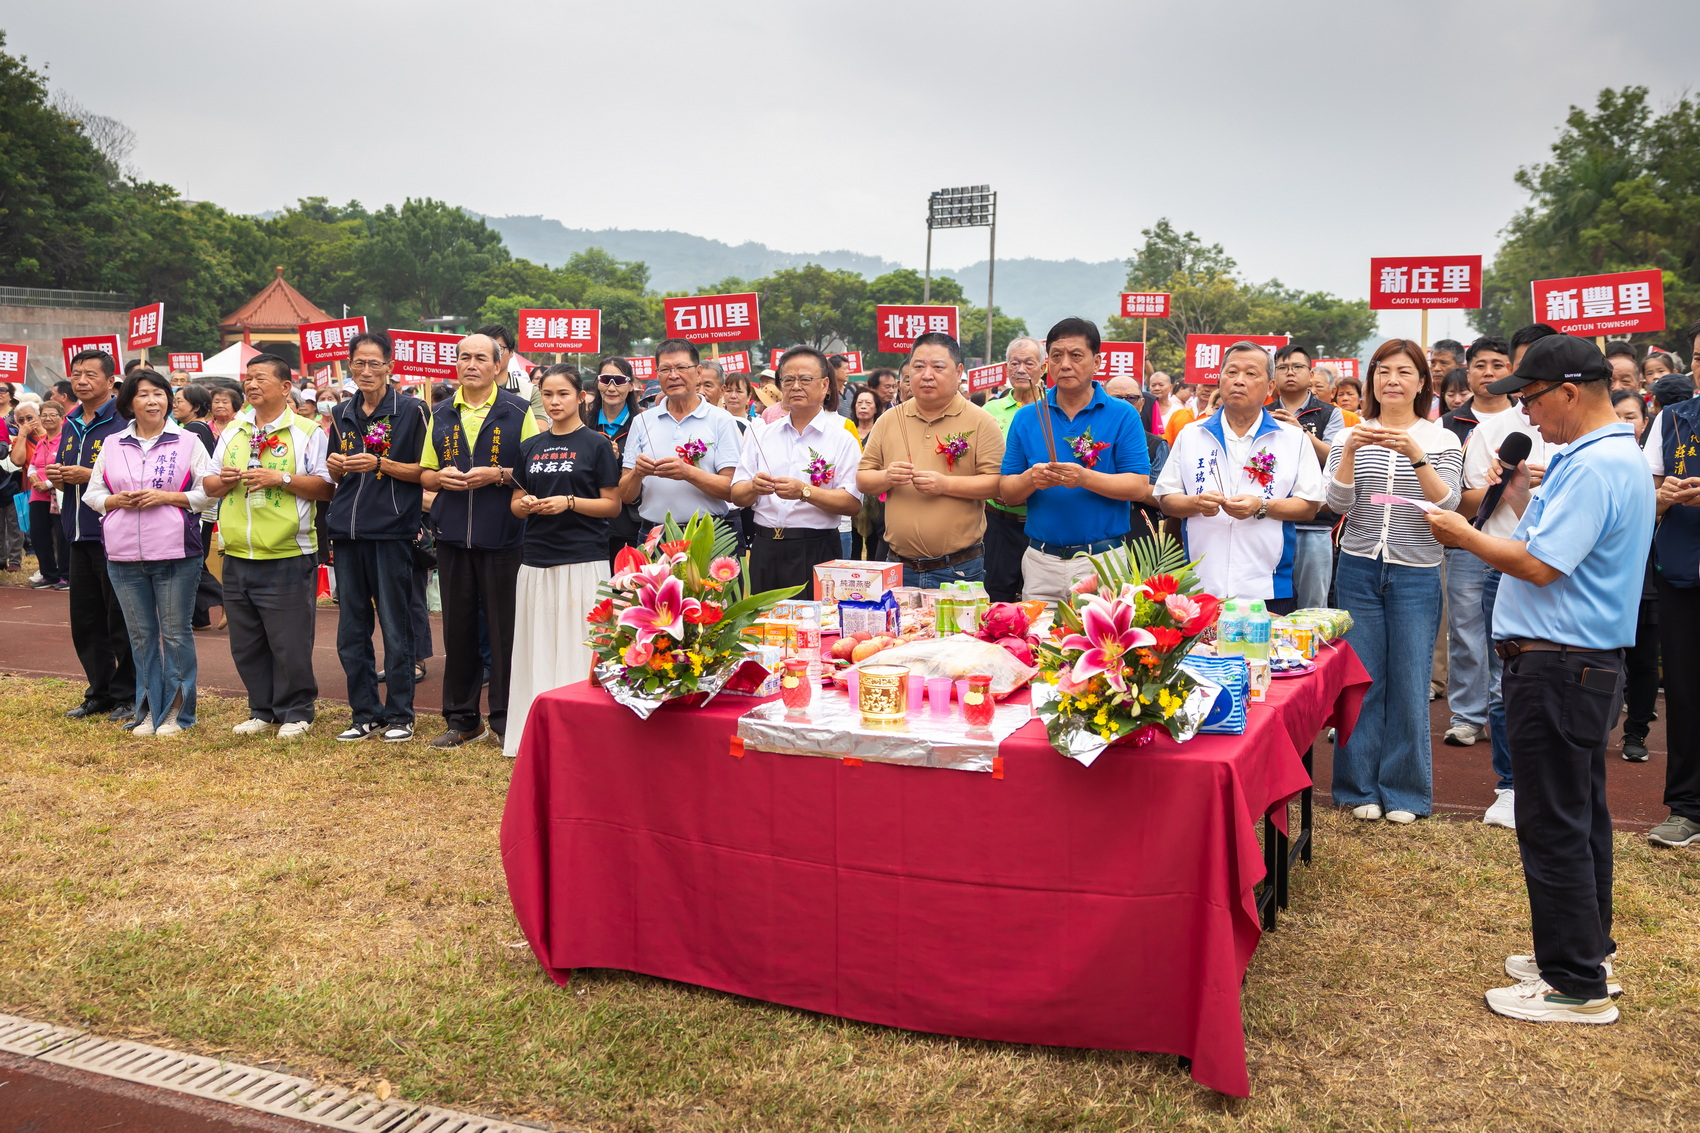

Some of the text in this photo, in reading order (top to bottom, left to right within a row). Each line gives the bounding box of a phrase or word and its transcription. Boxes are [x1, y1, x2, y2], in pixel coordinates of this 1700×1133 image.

[1380, 265, 1472, 294] 新庄里
[1545, 282, 1653, 321] 新豐里
[130, 311, 157, 338] 上林里
[525, 317, 592, 340] 碧峰里
[673, 302, 751, 331] 石川里
[884, 314, 949, 338] 北投里
[1561, 319, 1640, 333] CAOTUN TOWNSHIP
[305, 325, 361, 352] 復興里
[685, 330, 742, 340] CAOTUN TOWNSHIP
[394, 338, 458, 367] 新厝里
[402, 365, 451, 375] CAOTUN TOWNSHIP
[529, 460, 574, 474] 林友友
[839, 579, 872, 588] 純濃燕麥
